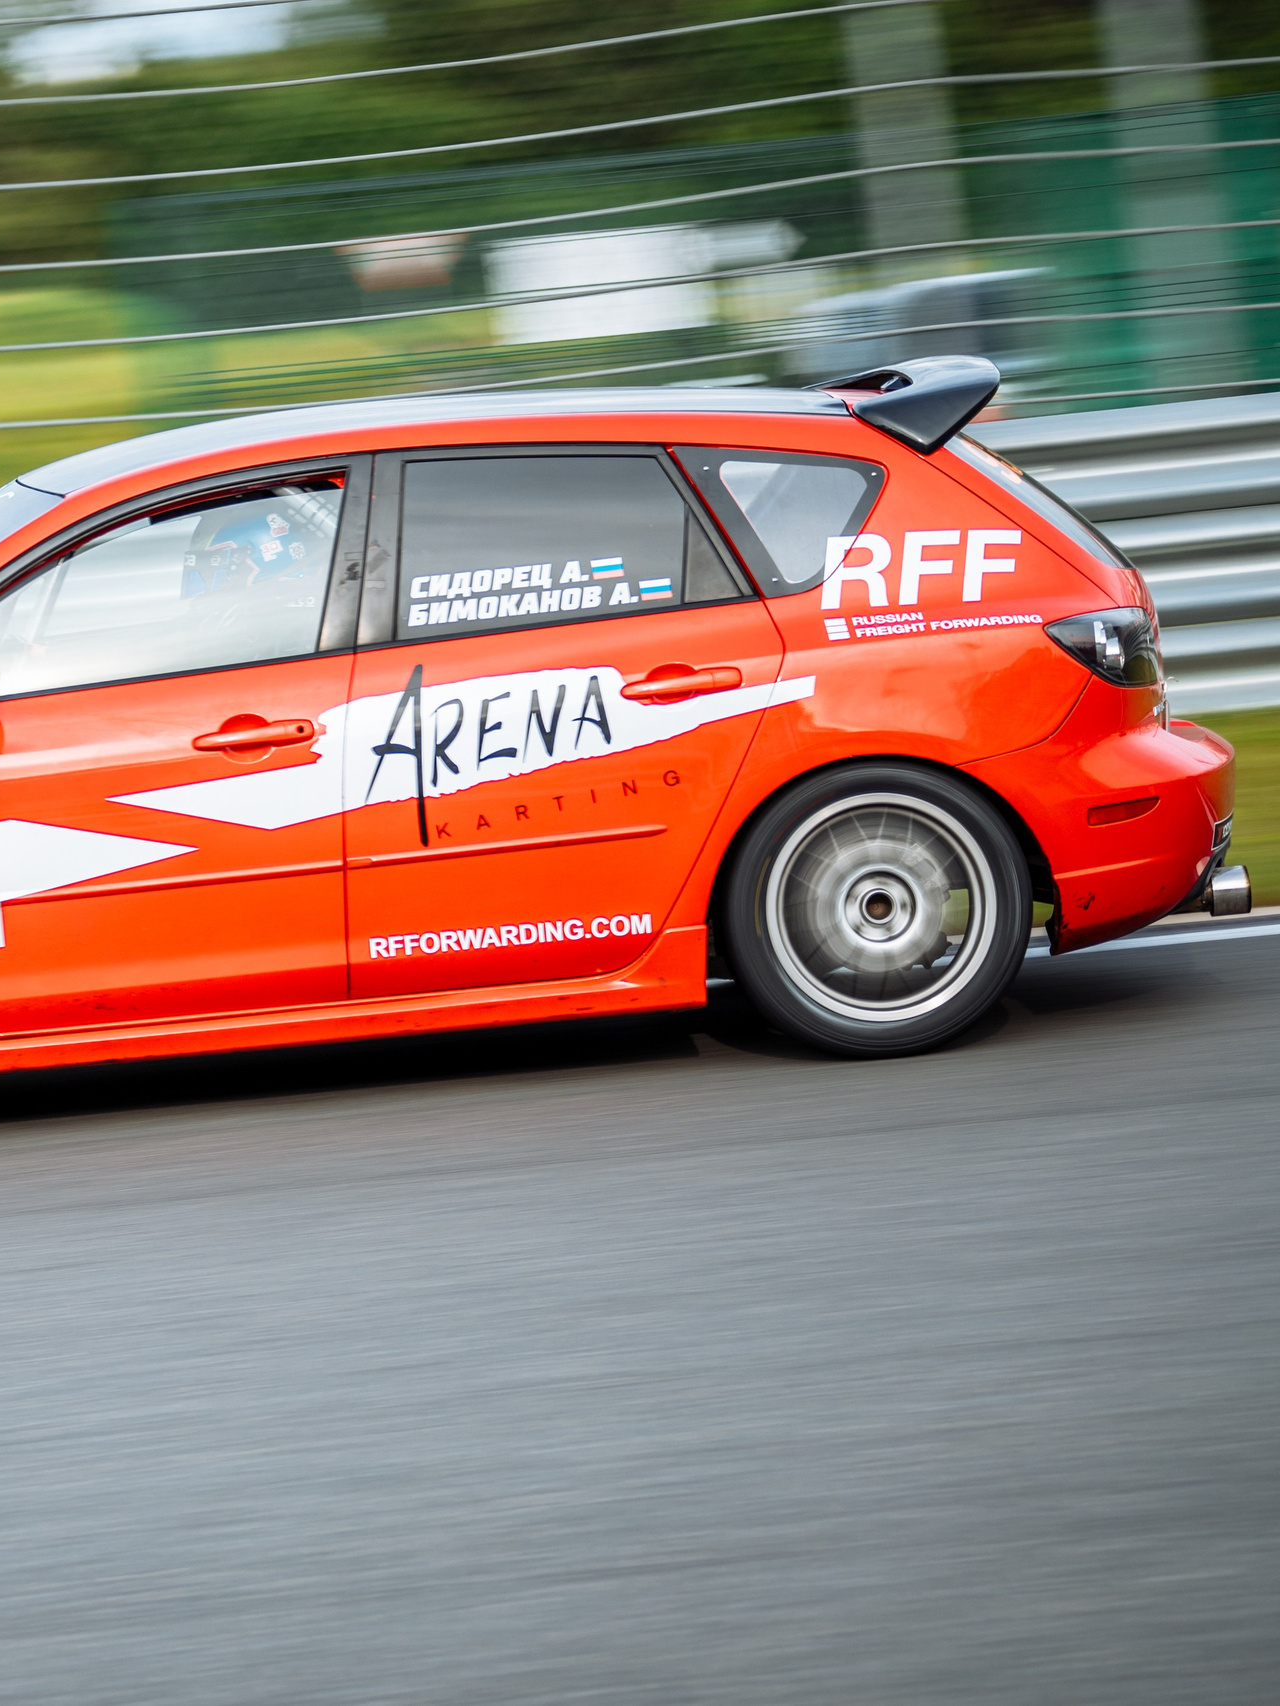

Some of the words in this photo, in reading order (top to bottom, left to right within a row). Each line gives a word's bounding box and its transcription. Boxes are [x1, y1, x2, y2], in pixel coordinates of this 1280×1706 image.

[409, 563, 553, 599] СИДОРЕЦ
[559, 560, 590, 584] А.
[821, 529, 1022, 610] RFF
[407, 585, 603, 627] БИМОКАНОВ
[608, 582, 639, 606] А.
[852, 611, 924, 627] RUSSIAN
[855, 622, 926, 638] FREIGHT
[931, 614, 1044, 631] FORWARDING
[364, 664, 612, 847] ARENA
[436, 769, 680, 839] KARTING
[369, 913, 652, 959] RFFORWARDING.COM
